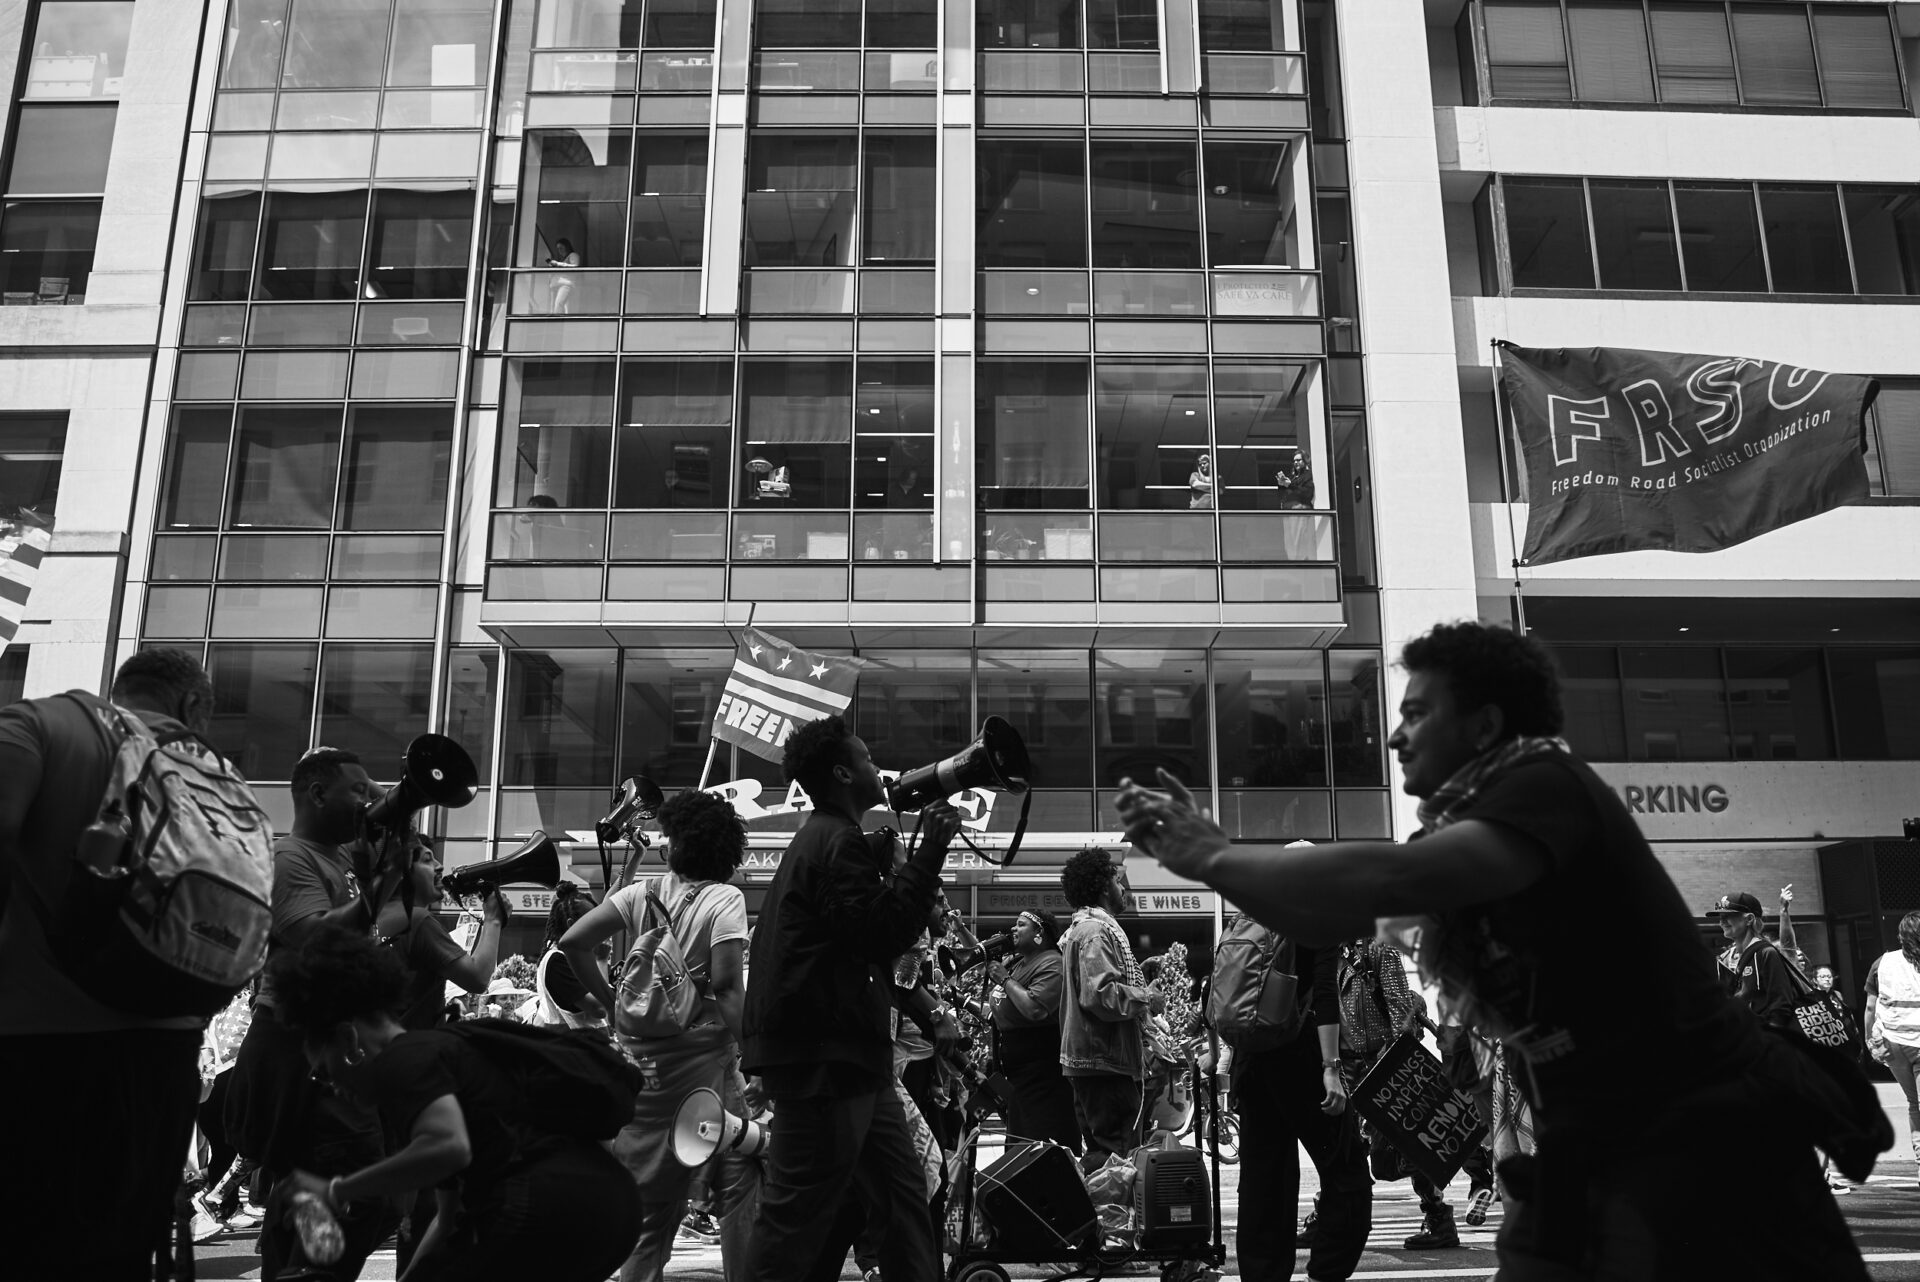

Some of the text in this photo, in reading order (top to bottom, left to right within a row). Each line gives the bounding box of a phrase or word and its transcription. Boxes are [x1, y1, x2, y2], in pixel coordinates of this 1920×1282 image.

[1216, 290, 1292, 301] SAFE VA CARE
[1551, 408, 1832, 496] Freedom Road Socialist Organization
[1625, 784, 1730, 814] RKING
[945, 852, 993, 868] ERN
[521, 893, 557, 908] STE
[990, 894, 1066, 908] PRIME BE
[1127, 895, 1201, 909] NE WINES
[1794, 1000, 1827, 1019] SURF
[1803, 1018, 1844, 1039] FOUND
[1812, 1030, 1849, 1047] TION
[1372, 1049, 1425, 1109] NO KINGS
[1387, 1055, 1442, 1122] IMPEACH
[1417, 1088, 1474, 1151] REMOVE
[1436, 1104, 1481, 1163] NO ICE
